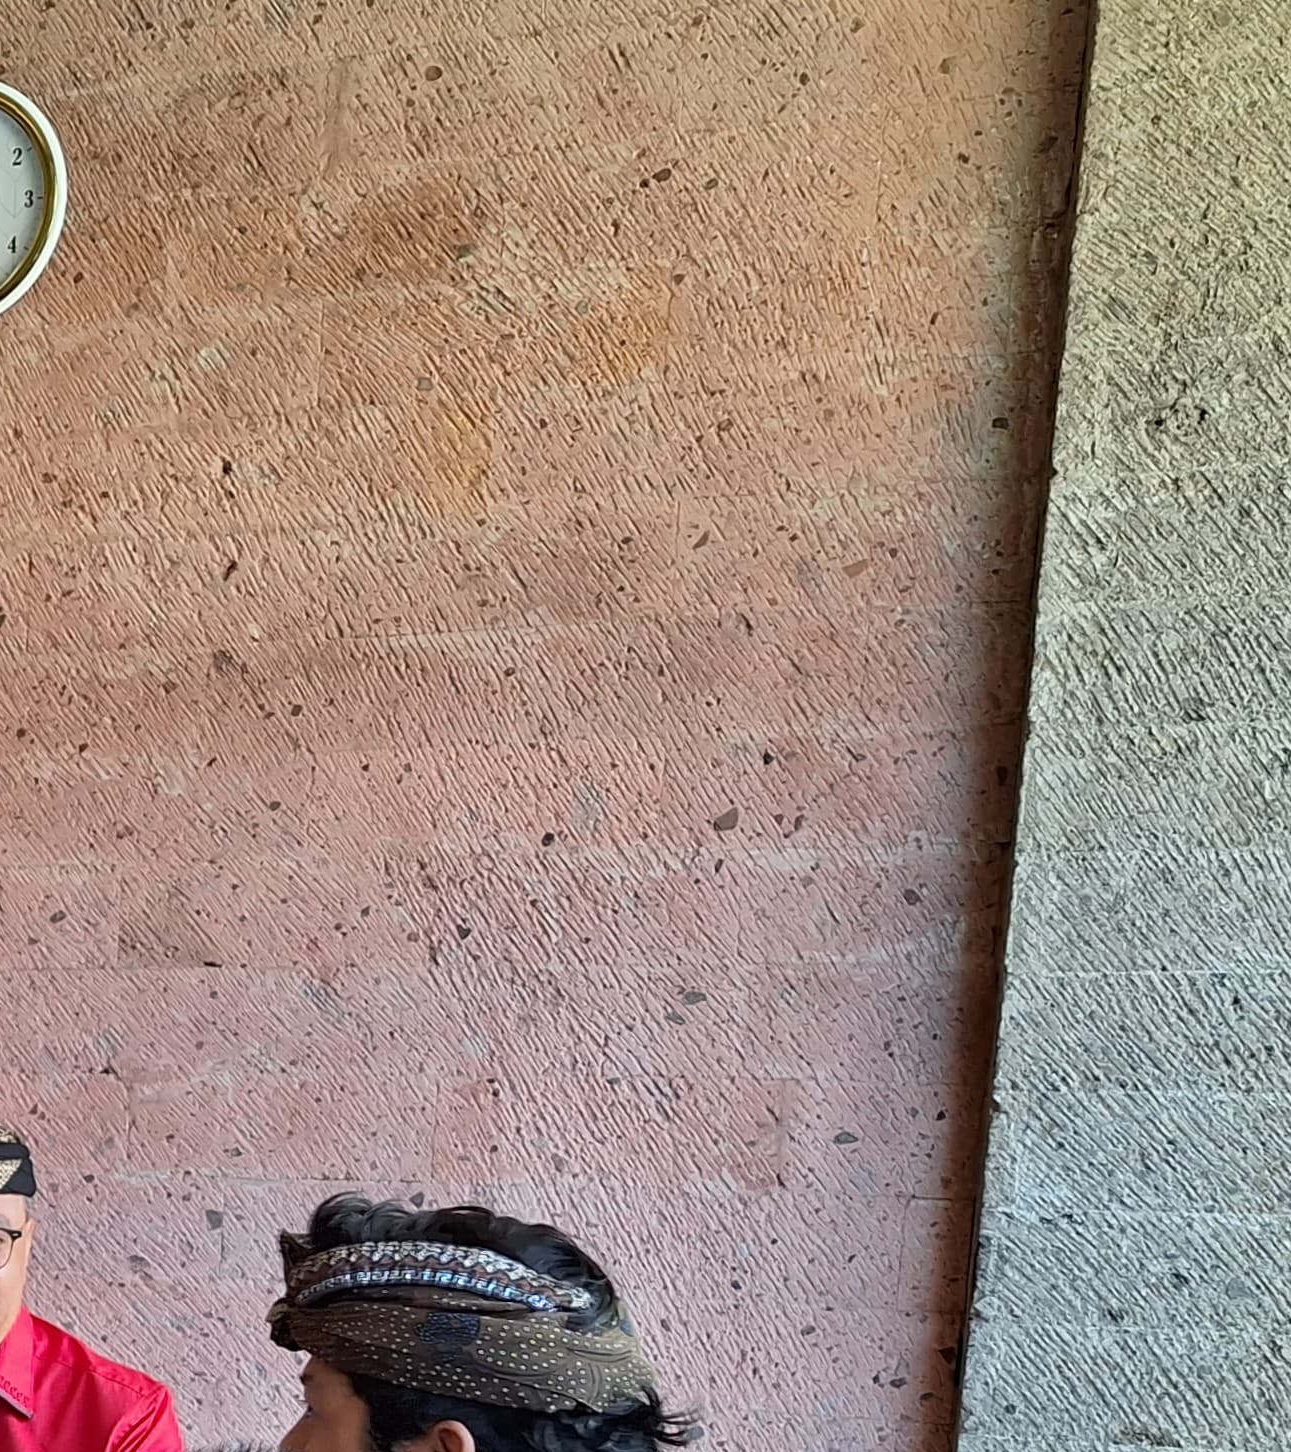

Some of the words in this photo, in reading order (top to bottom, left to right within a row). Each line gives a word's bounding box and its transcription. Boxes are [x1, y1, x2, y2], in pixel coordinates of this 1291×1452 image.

[12, 148, 23, 167] 2
[24, 190, 34, 208] 3
[7, 236, 17, 254] 4
